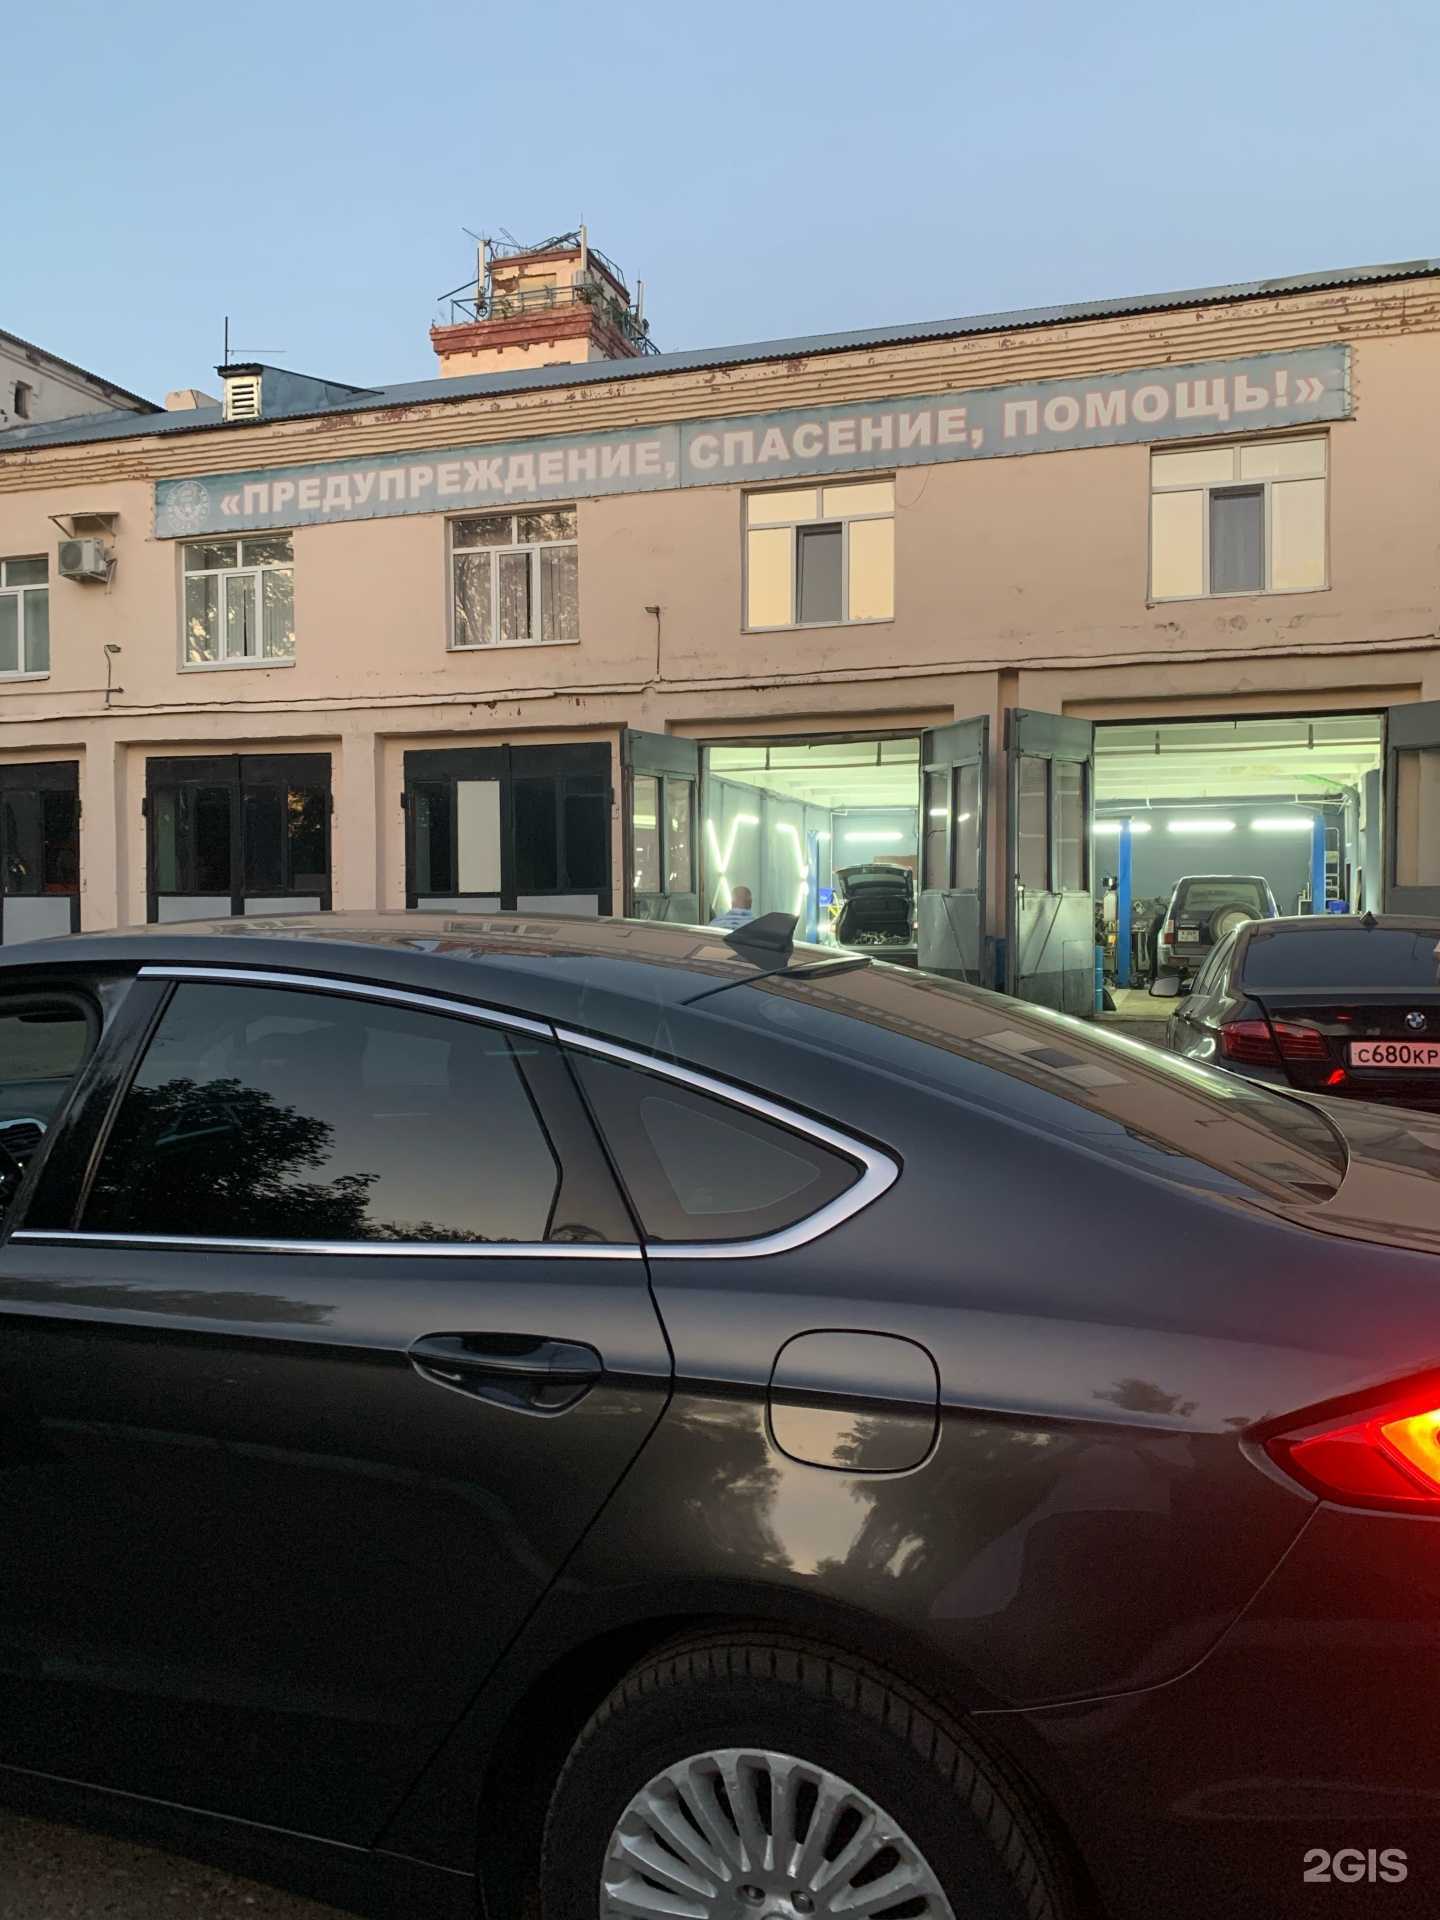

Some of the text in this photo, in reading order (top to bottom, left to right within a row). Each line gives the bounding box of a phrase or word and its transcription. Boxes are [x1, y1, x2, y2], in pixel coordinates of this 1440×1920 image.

[219, 440, 676, 516] «ПРЕДУПРЕЖДЕНИЕ,
[688, 408, 985, 469] СПАСЕНИЕ,
[1003, 370, 1326, 438] ПОМОЩЬ!»
[1358, 1045, 1439, 1064] С680КР
